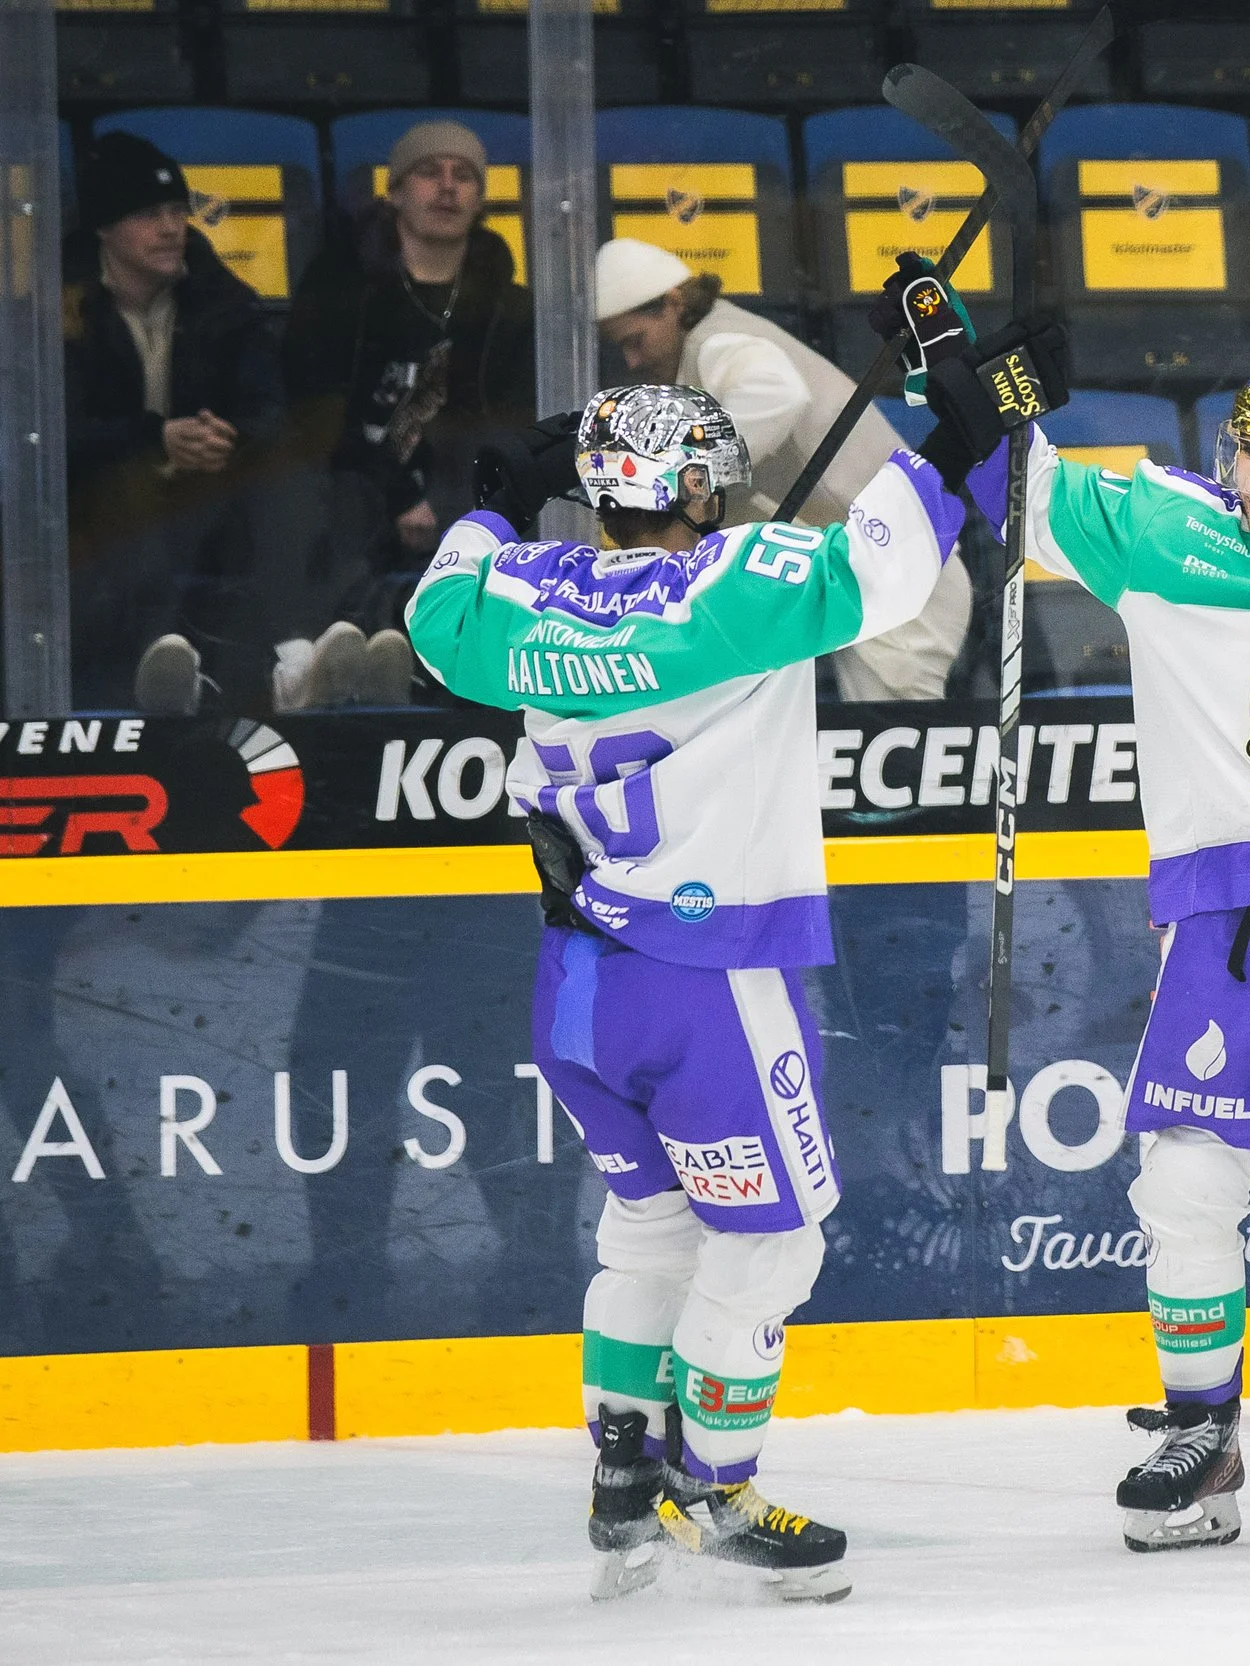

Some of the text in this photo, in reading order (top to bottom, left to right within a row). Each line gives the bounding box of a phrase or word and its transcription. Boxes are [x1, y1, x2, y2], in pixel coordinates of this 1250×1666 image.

[991, 371, 1020, 414] JOHN
[1005, 354, 1041, 417] SCOTT'S
[588, 477, 619, 487] PAIKKA
[743, 523, 825, 584] 50
[1008, 581, 1018, 606] PRO
[508, 647, 661, 696] AALTONEN
[0, 719, 146, 754] ENE
[375, 737, 527, 821] KO
[997, 755, 1017, 897] CCM
[673, 893, 713, 909] MESTIS
[663, 1140, 765, 1170] CABLE
[786, 1101, 827, 1191] HALTI
[678, 1172, 764, 1200] CREW
[1150, 1301, 1226, 1322] Brand
[1154, 1333, 1213, 1349] rändillesi
